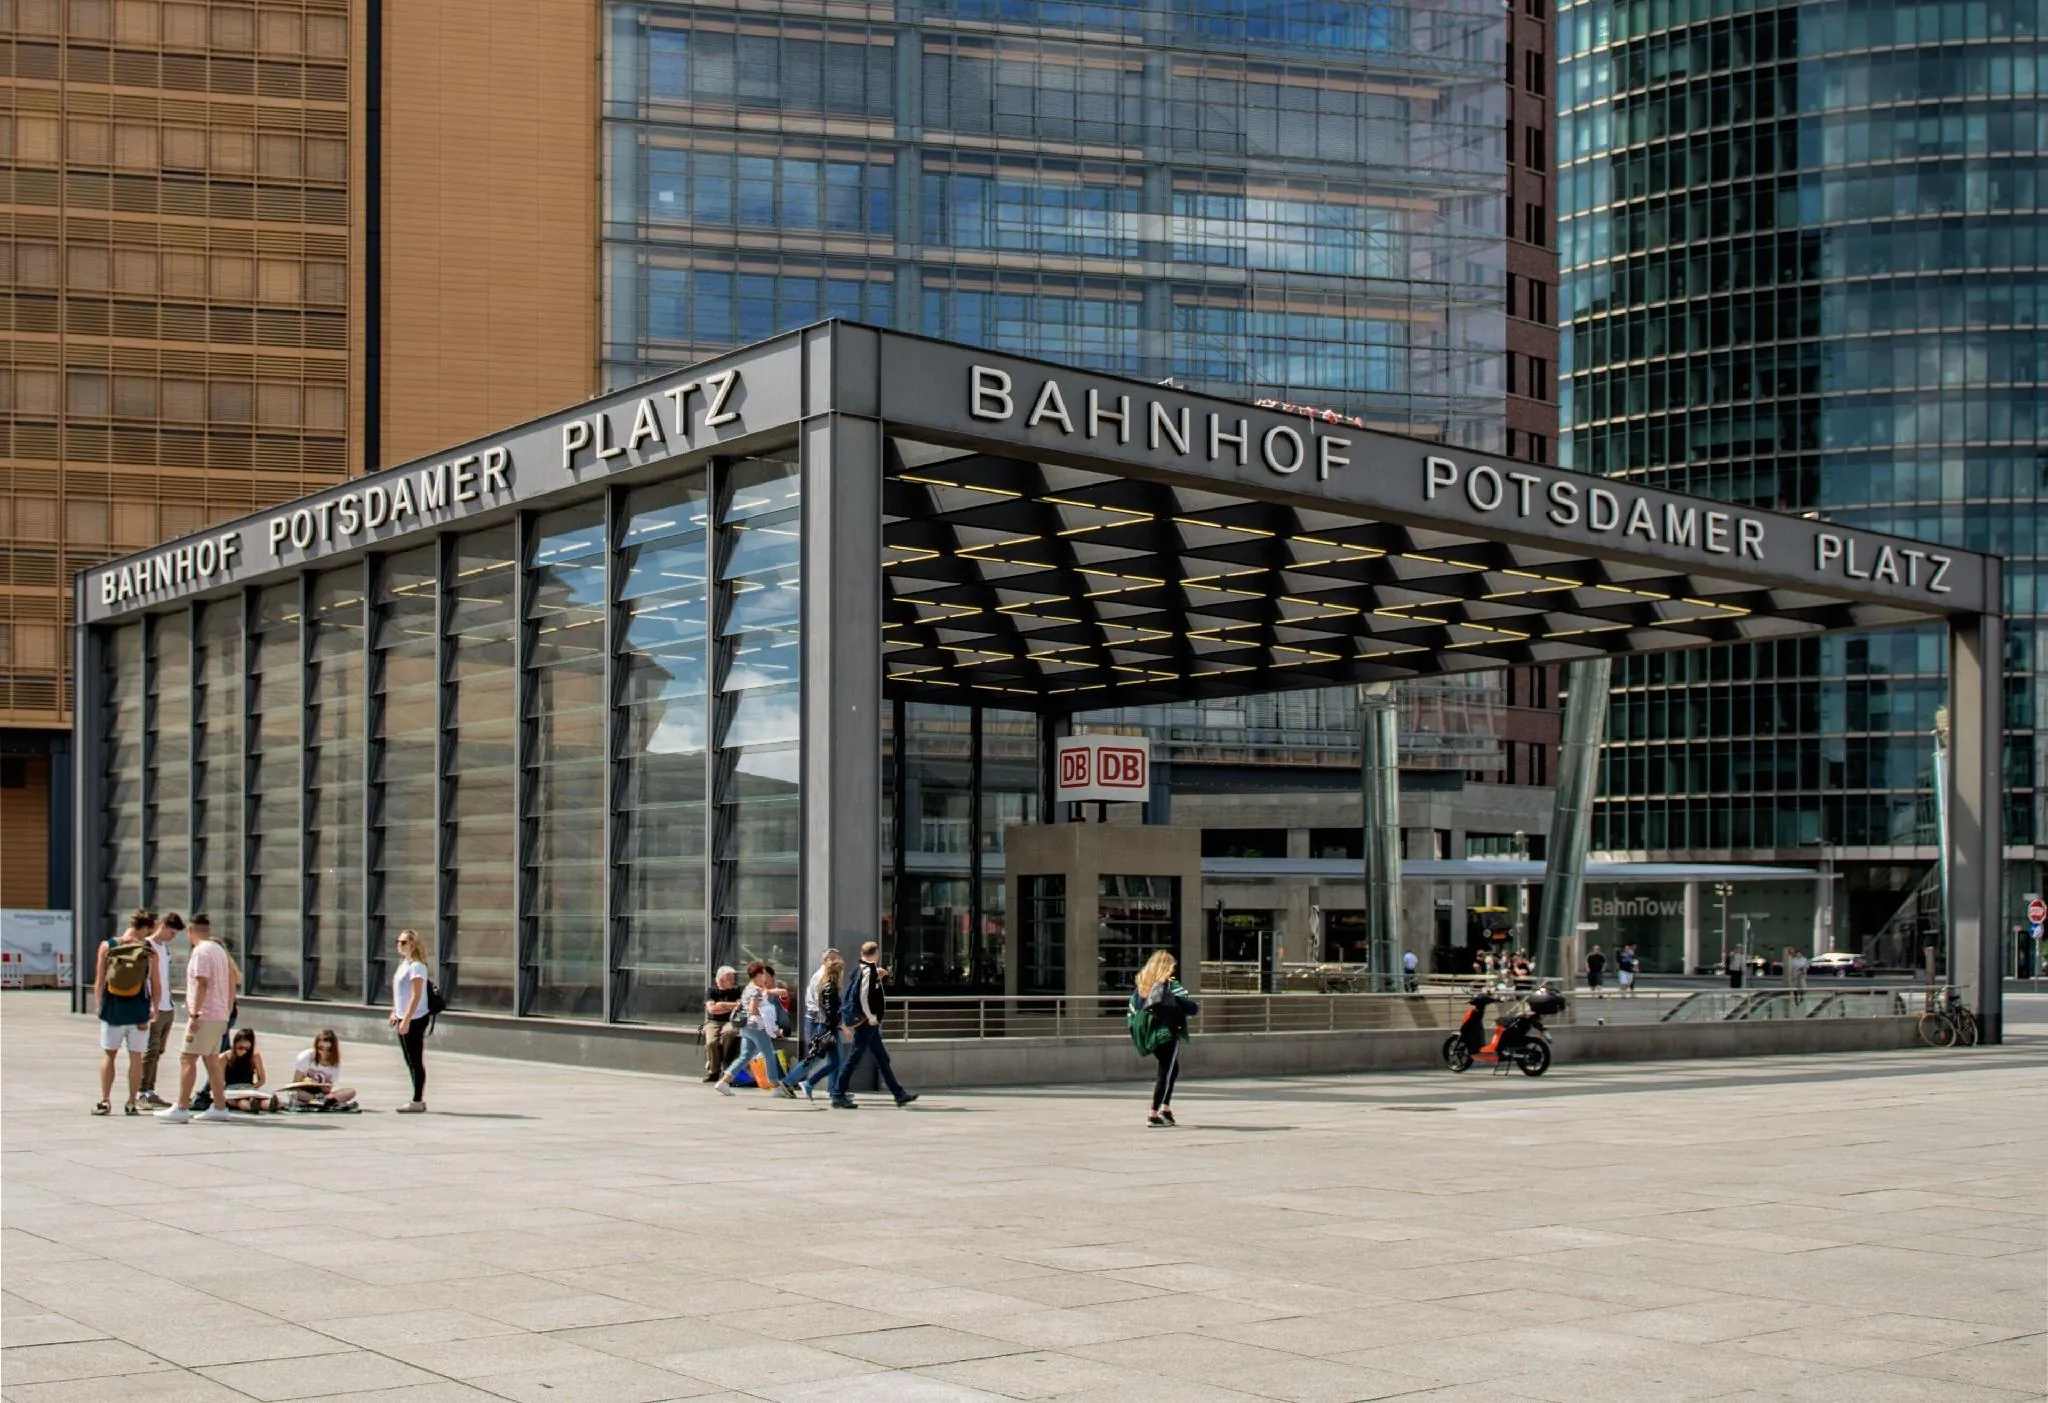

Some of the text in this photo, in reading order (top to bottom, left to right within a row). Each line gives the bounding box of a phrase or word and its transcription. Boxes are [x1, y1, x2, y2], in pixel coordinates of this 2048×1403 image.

[100, 369, 741, 606] BAHNHOF POTSDAMER PLATZ
[970, 364, 1953, 593] BAHNHOF POTSDAMER PLATZ
[1063, 754, 1087, 781] DB
[1102, 753, 1140, 781] DB
